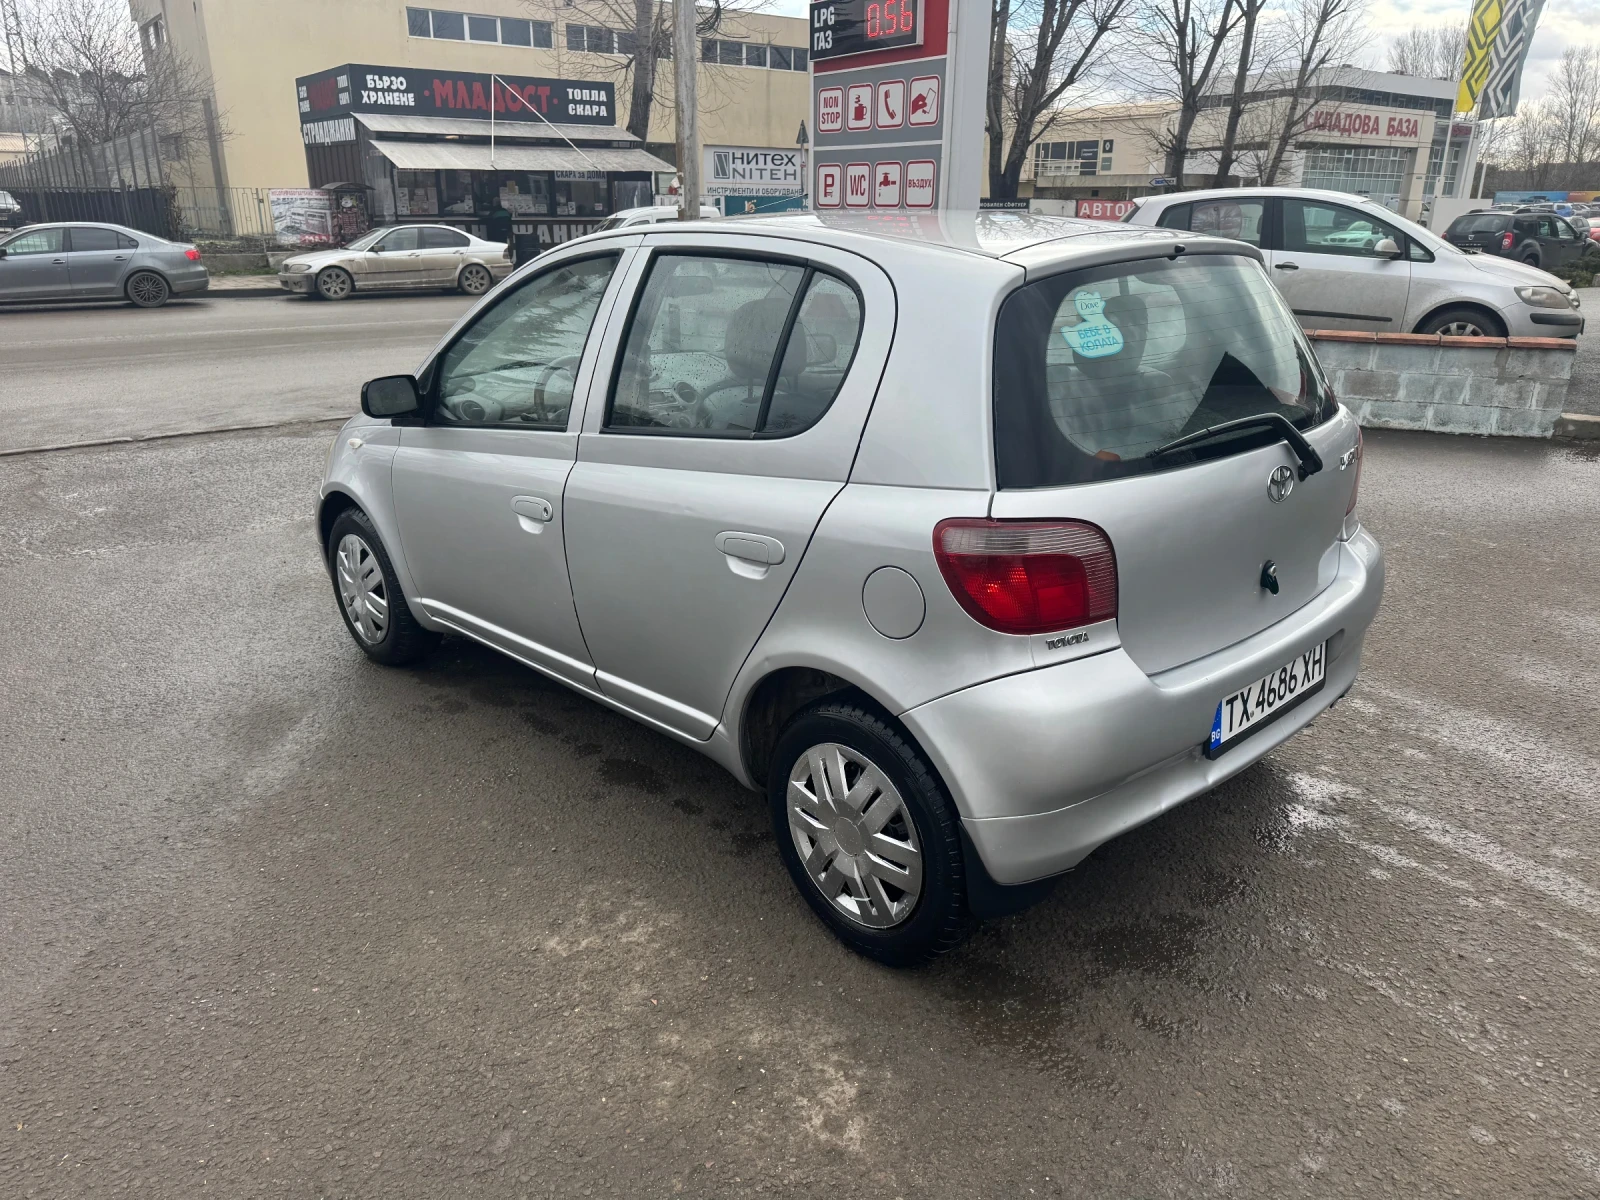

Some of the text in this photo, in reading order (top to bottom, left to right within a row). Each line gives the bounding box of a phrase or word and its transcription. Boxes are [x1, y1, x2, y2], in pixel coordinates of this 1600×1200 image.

[814, 6, 835, 28] LPG
[867, 0, 912, 37] 0.56
[814, 30, 833, 51] ГАЗ
[366, 74, 407, 90] БЪРЗО
[361, 90, 415, 106] ХРАНЕНЕ
[432, 79, 550, 113] МЛАДОСТ
[567, 88, 607, 102] ТОПЛА
[823, 96, 839, 109] NON
[568, 103, 607, 117] СКАРА
[821, 112, 841, 125] STOP
[1303, 110, 1419, 138] СКЛАДОВА БАЗА
[302, 118, 356, 146] СТРАНДЖАНКИ
[587, 171, 605, 181] ДОМА
[732, 168, 797, 180] NITEH
[707, 187, 752, 195] ИНСТРУМЕНТИ
[756, 187, 760, 195] И
[850, 174, 866, 196] WC
[908, 179, 932, 190] ВЪЗДУХ
[1081, 301, 1099, 310] Dove
[1078, 324, 1111, 339] БЕБЕ В
[1080, 336, 1120, 352] КОЛАТА
[1046, 631, 1090, 651] TOYOTA
[1255, 659, 1298, 714] 4686
[1211, 729, 1221, 743] BG
